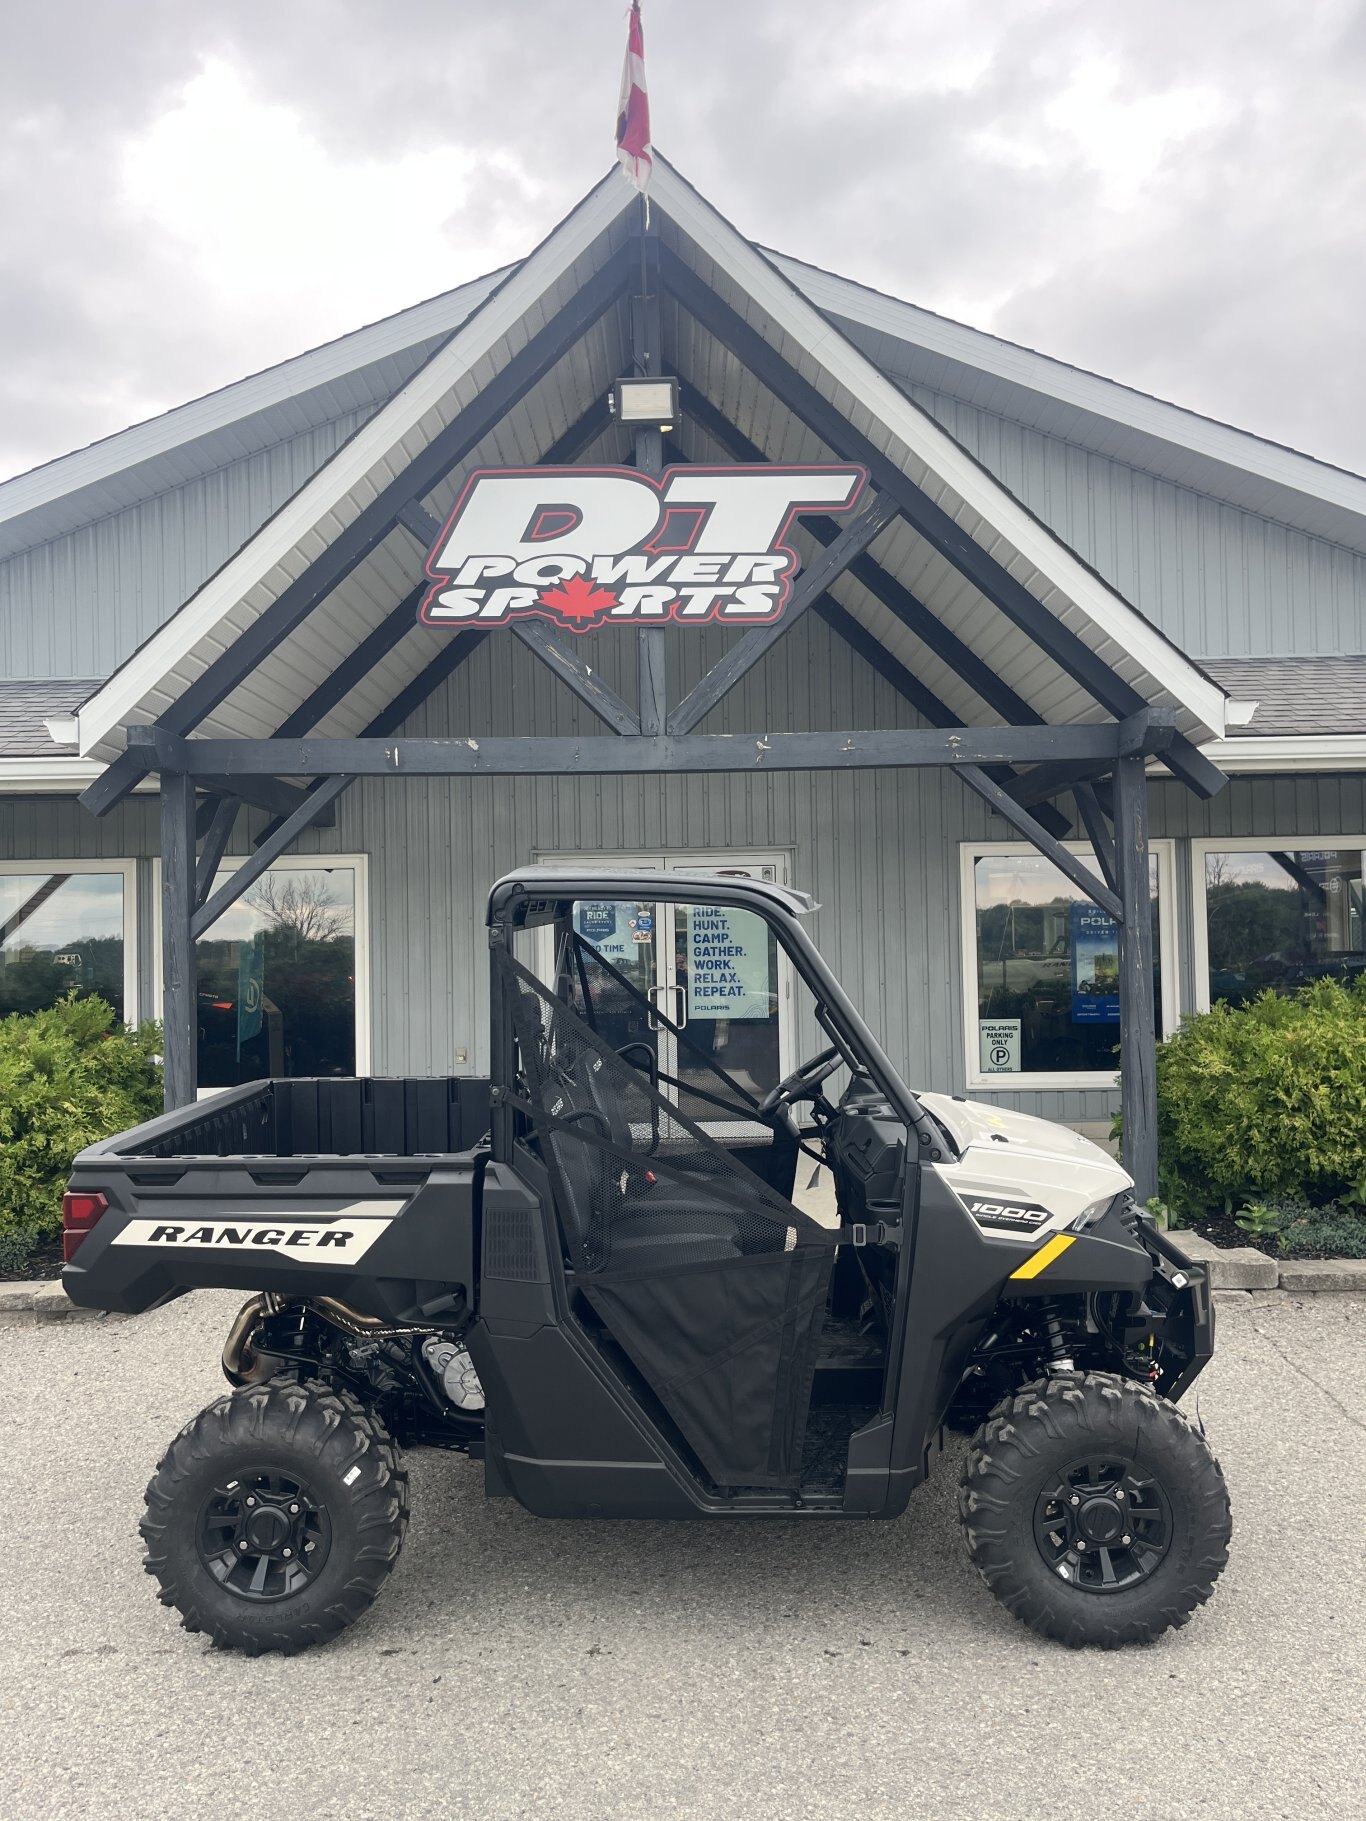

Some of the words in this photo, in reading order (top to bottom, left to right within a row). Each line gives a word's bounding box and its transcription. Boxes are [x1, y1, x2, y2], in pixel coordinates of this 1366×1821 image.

[436, 475, 858, 568] DT
[453, 554, 789, 586] POWER
[430, 585, 781, 618] SPRTS
[586, 911, 609, 920] RIDE
[693, 907, 725, 917] RIDE.
[693, 920, 730, 930] HUNT.
[693, 933, 732, 943] CAMP.
[603, 944, 625, 952] TIME
[693, 946, 746, 957] GATHER.
[694, 960, 735, 970] WORK.
[694, 973, 740, 983] RELAX.
[694, 986, 746, 996] REPEAT.
[970, 1202, 1048, 1221] 1000
[147, 1225, 355, 1248] RANGER
